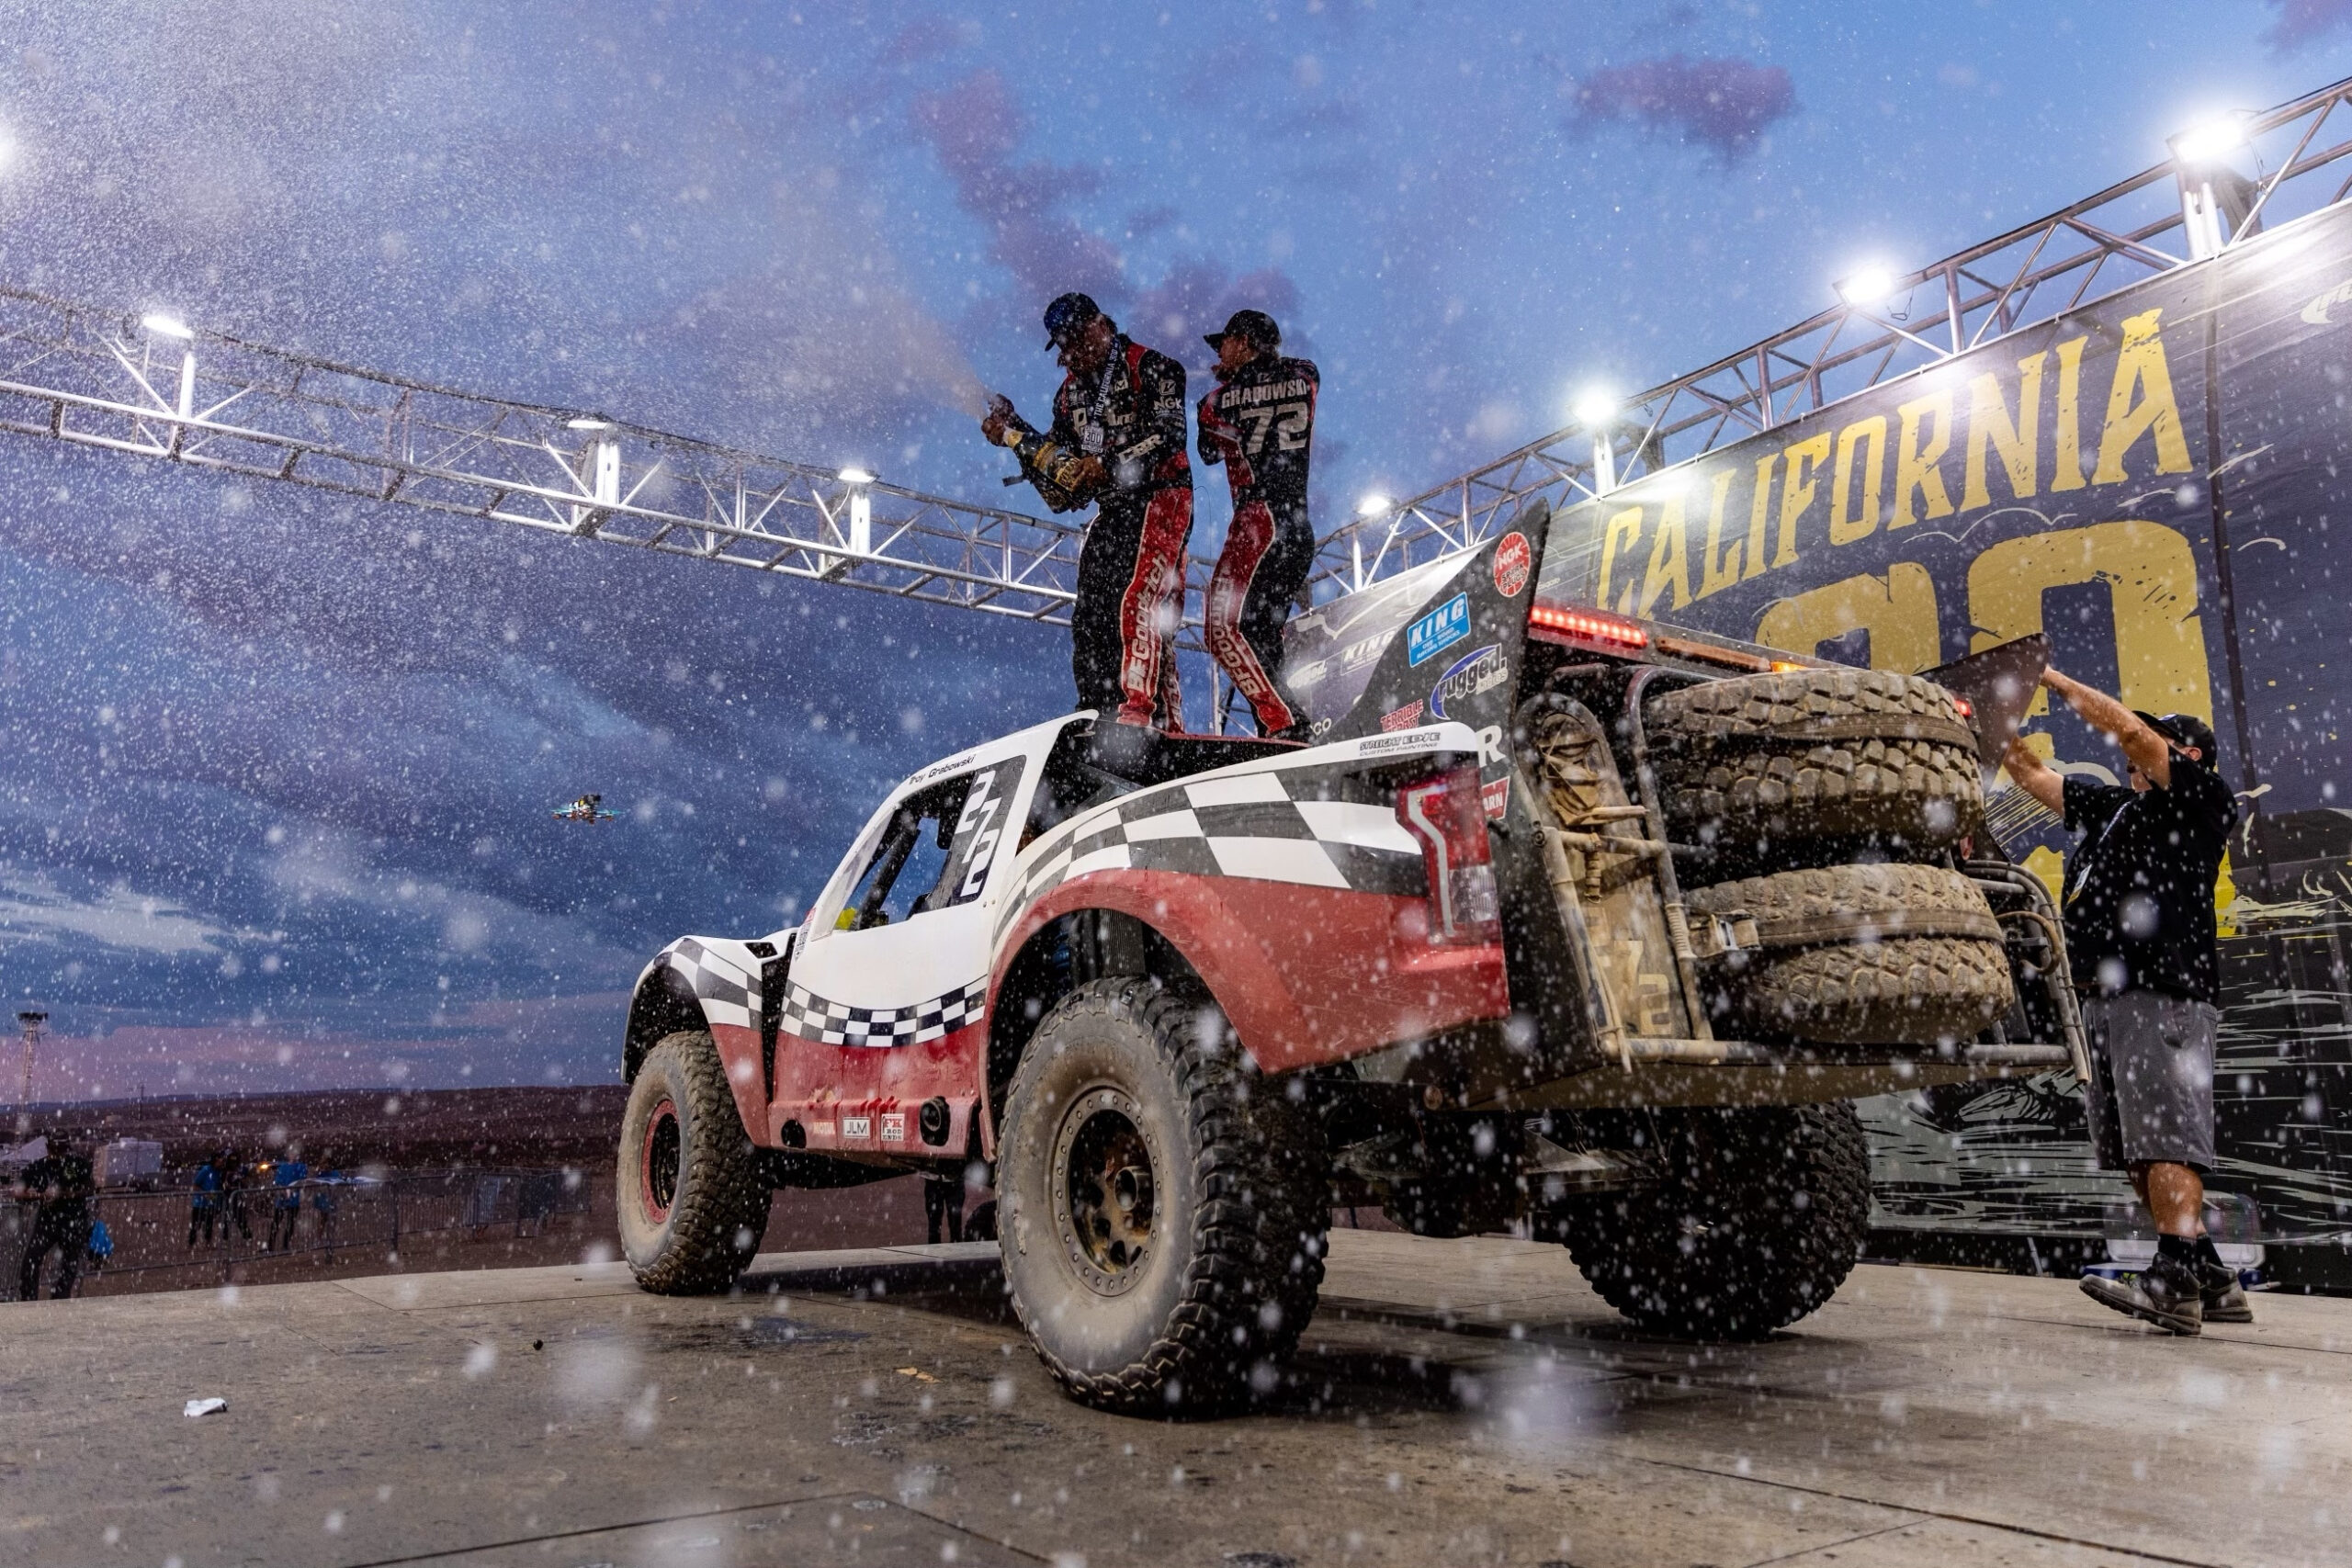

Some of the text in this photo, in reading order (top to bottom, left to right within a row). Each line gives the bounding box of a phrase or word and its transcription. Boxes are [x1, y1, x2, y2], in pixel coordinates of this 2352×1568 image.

[1098, 363, 1115, 401] CALIFORNIA
[1221, 378, 1307, 409] GRABOWSKI
[1093, 401, 1104, 417] THE
[1154, 397, 1182, 411] NGK
[1238, 401, 1308, 455] 72
[1597, 308, 2193, 619] CALIFORNIA
[1498, 542, 1523, 570] NGK
[1501, 563, 1524, 582] SPARK
[1502, 571, 1525, 589] PLUGS
[1127, 554, 1169, 692] BFGoodrich
[1411, 599, 1464, 648] KING
[1380, 698, 1423, 732] TERRIBLE
[1360, 742, 1438, 757] CUSTOM PAINTING
[928, 754, 977, 778] Grabowski
[1483, 791, 1503, 812] ARN
[847, 1121, 867, 1134] JLM
[883, 1118, 902, 1128] FK
